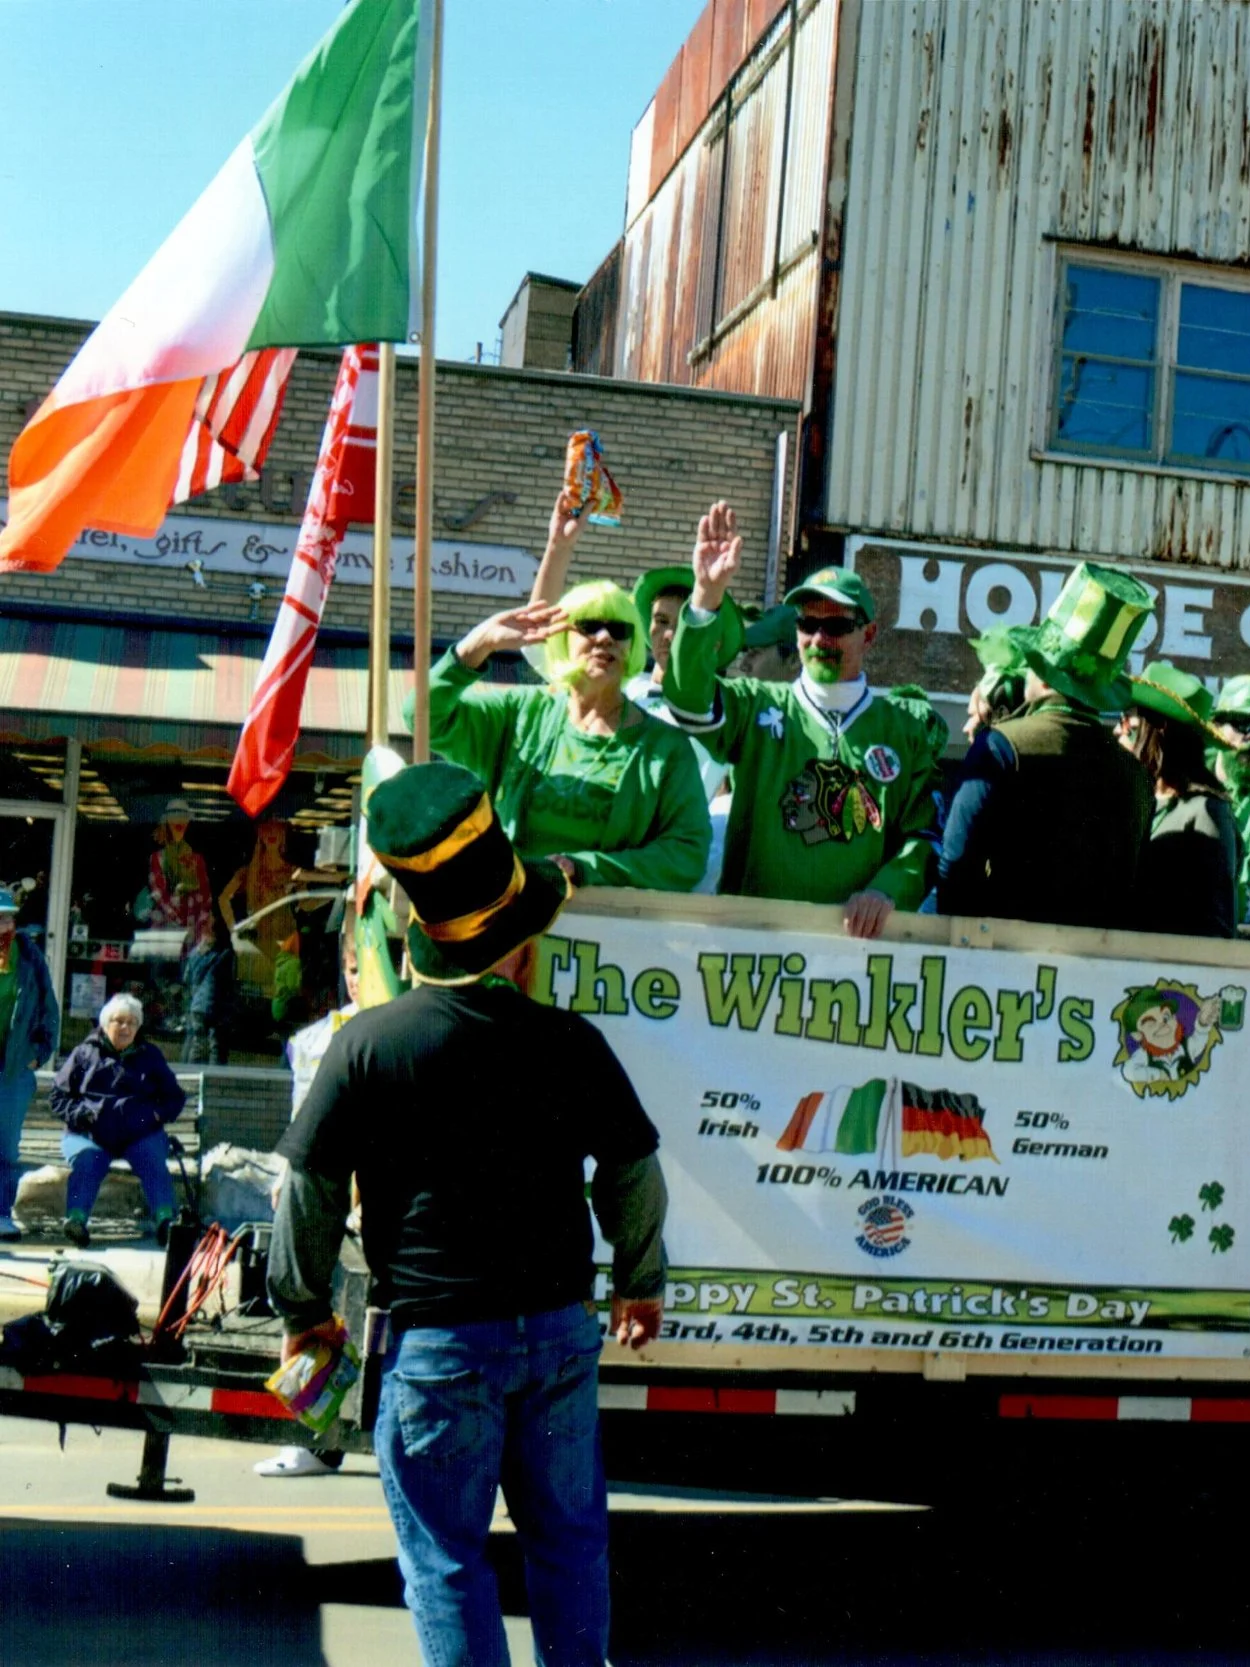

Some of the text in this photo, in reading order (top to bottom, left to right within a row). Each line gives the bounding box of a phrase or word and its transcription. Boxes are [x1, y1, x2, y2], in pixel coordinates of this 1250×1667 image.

[242, 534, 289, 564] &
[405, 551, 517, 584] fshion
[893, 555, 1215, 660] HOE
[533, 933, 1096, 1063] The Winkler's
[700, 1090, 761, 1111] 50%
[697, 1118, 760, 1139] Irish
[1014, 1110, 1070, 1131] 50%
[1011, 1137, 1110, 1159] German
[756, 1163, 1011, 1197] 100% AMERICAN
[857, 1194, 915, 1219] GOD BLESS
[855, 1234, 912, 1258] AMERICA
[594, 1272, 1151, 1327] Hppy St. Patrick's Day
[659, 1320, 1164, 1354] 3rd, 4th, 5th and 6th Generation
